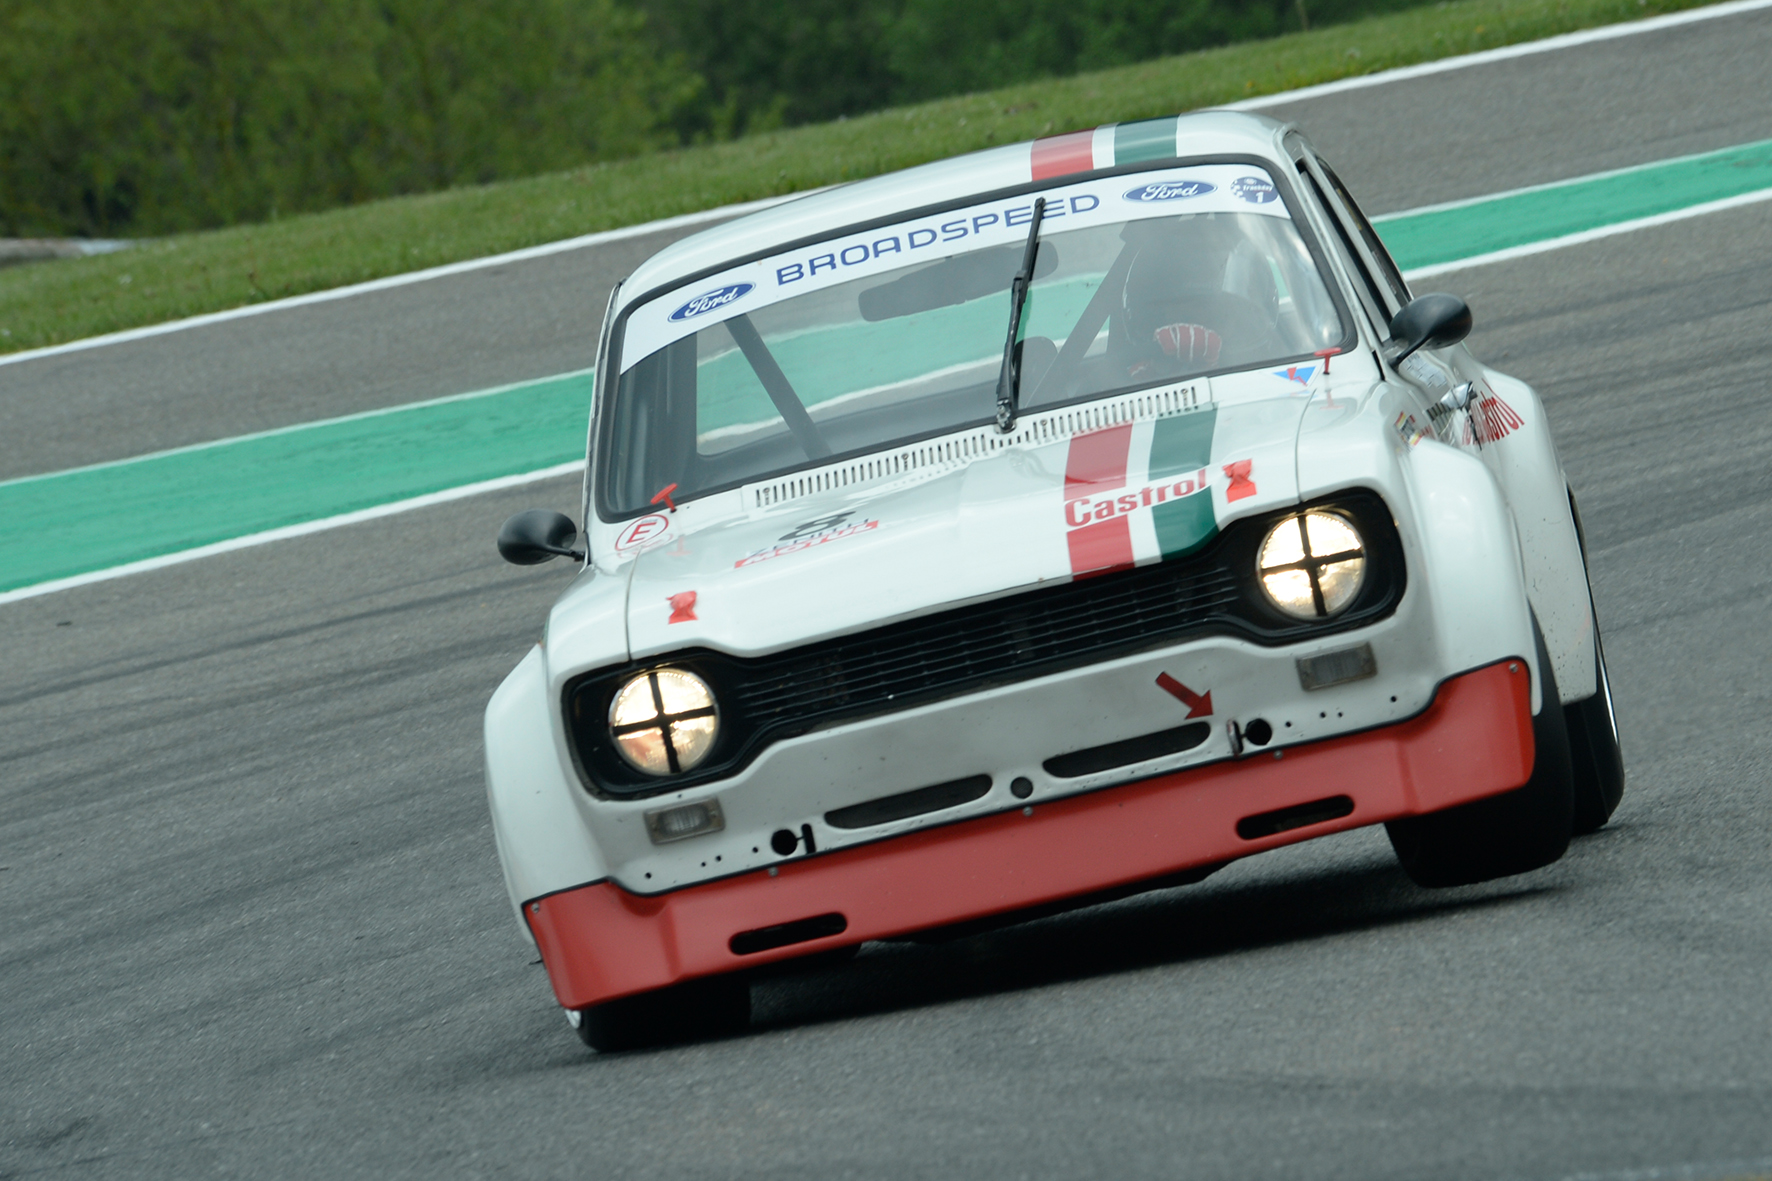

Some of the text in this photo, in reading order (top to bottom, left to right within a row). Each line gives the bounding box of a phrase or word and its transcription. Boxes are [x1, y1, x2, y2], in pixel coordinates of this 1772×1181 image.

[1141, 182, 1199, 201] Ford
[1255, 191, 1264, 203] 1
[776, 194, 1100, 286] BROADSPEED
[684, 286, 739, 317] Ford
[1065, 467, 1206, 527] Castrol
[625, 521, 657, 544] E
[778, 511, 856, 541] 8
[741, 523, 875, 567] MOTUL
